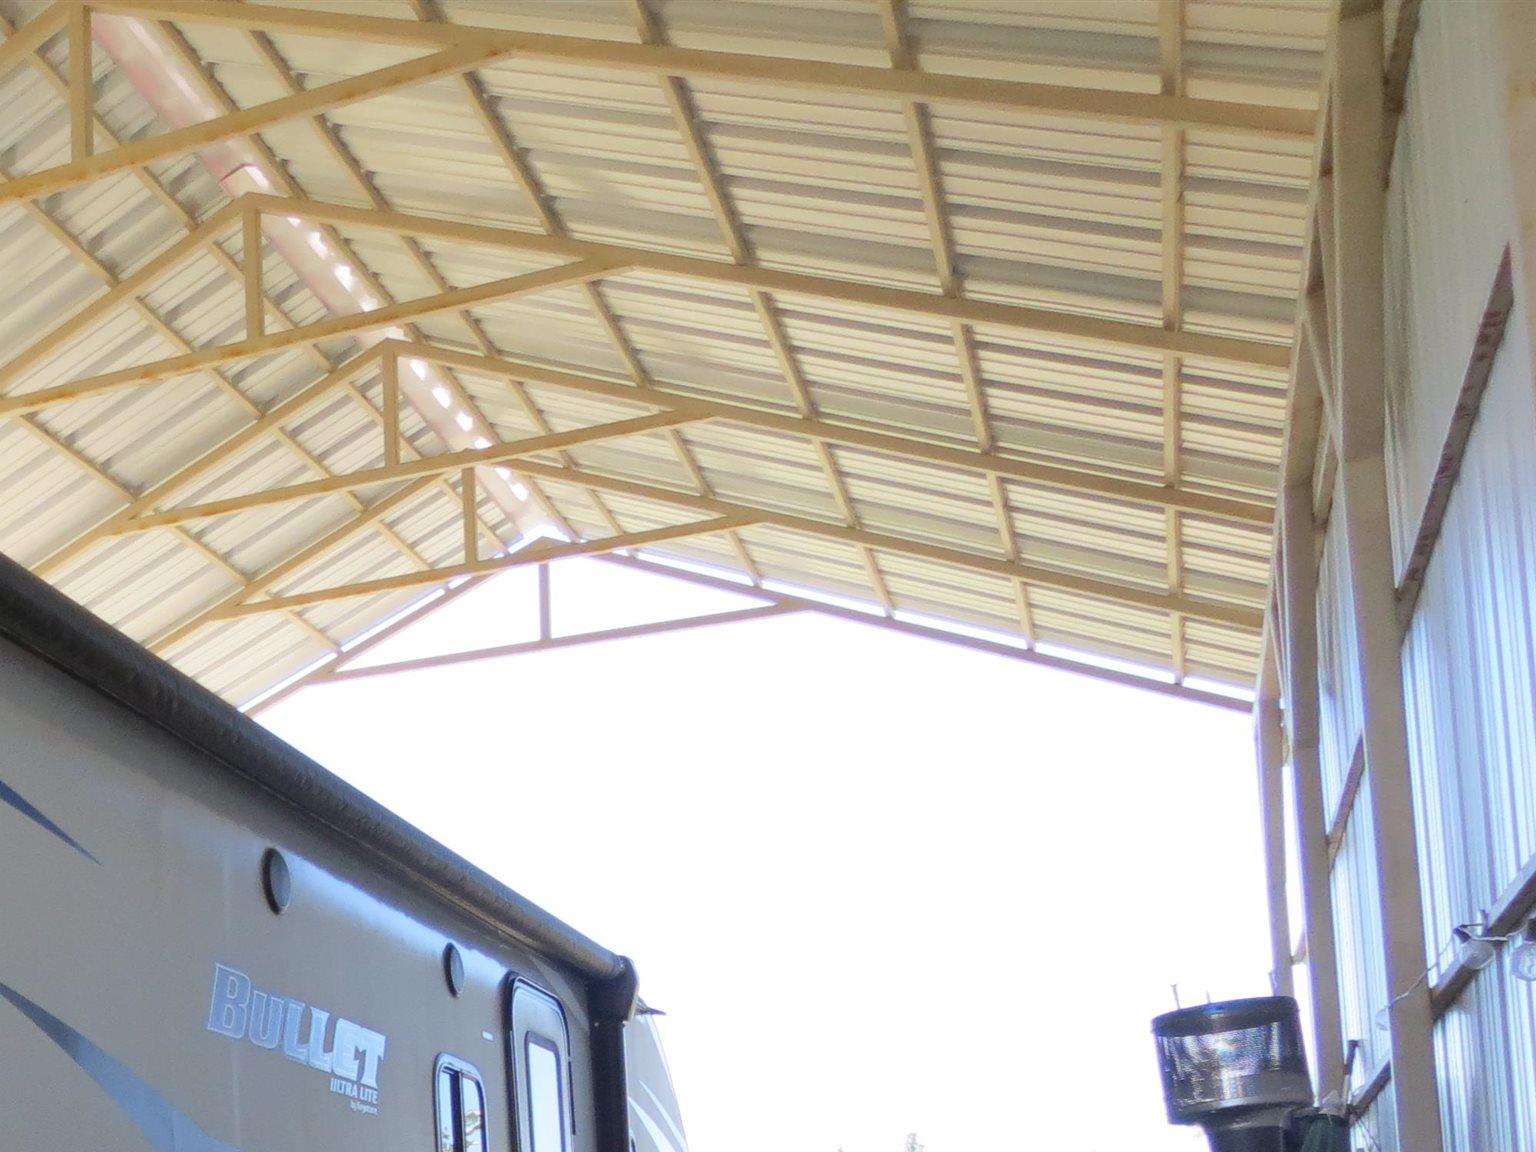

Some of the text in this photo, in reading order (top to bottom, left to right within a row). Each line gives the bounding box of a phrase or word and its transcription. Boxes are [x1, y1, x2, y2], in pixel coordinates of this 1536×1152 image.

[207, 962, 386, 1088] BULLET
[330, 1077, 379, 1105] ULTRA LITE
